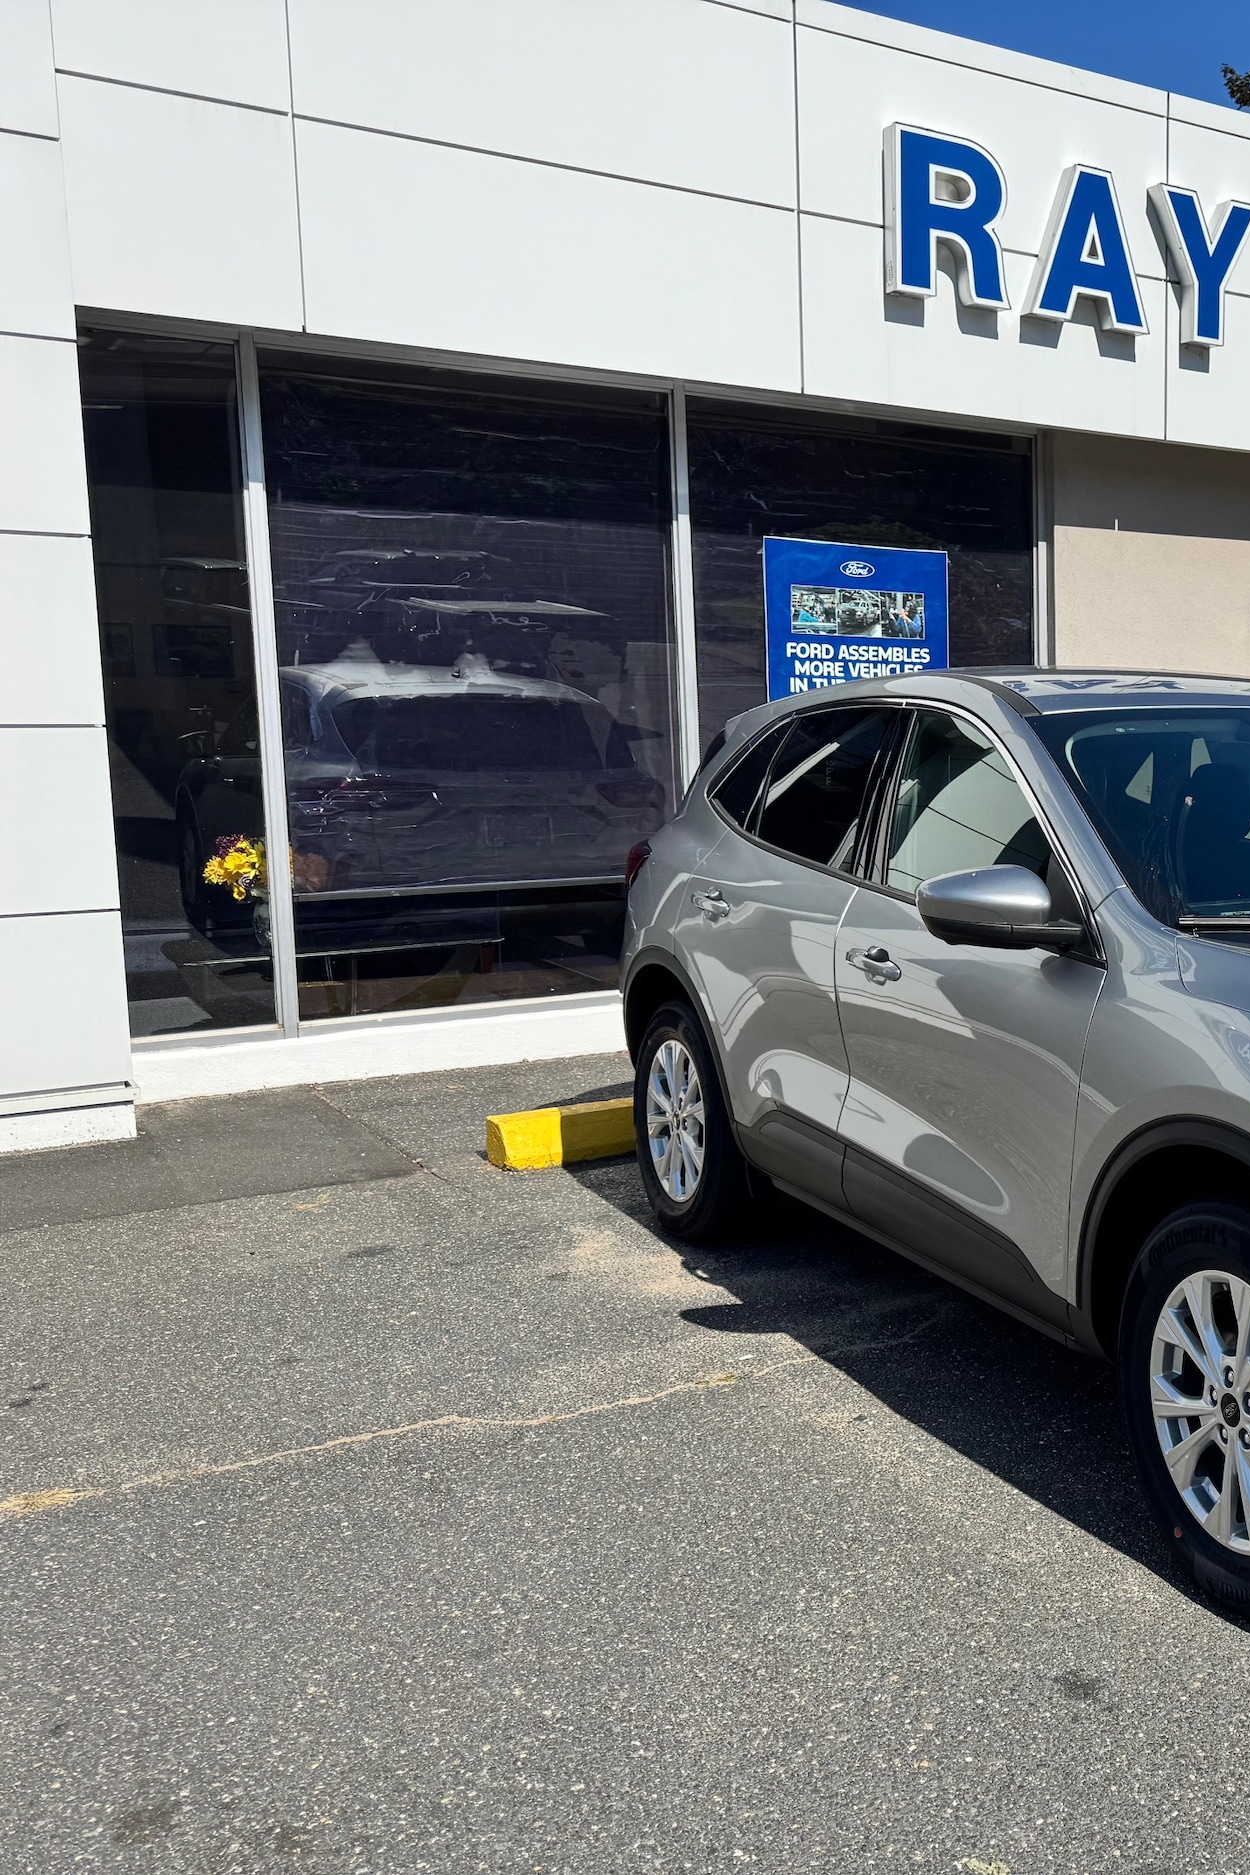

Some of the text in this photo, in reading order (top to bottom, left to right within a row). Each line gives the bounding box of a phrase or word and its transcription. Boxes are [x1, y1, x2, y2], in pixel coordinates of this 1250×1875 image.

[844, 562, 871, 576] Ford
[786, 642, 930, 662] FORD ASSEMBLES
[794, 660, 844, 677] MORE
[789, 678, 808, 692] IN
[1149, 1227, 1216, 1267] Continental
